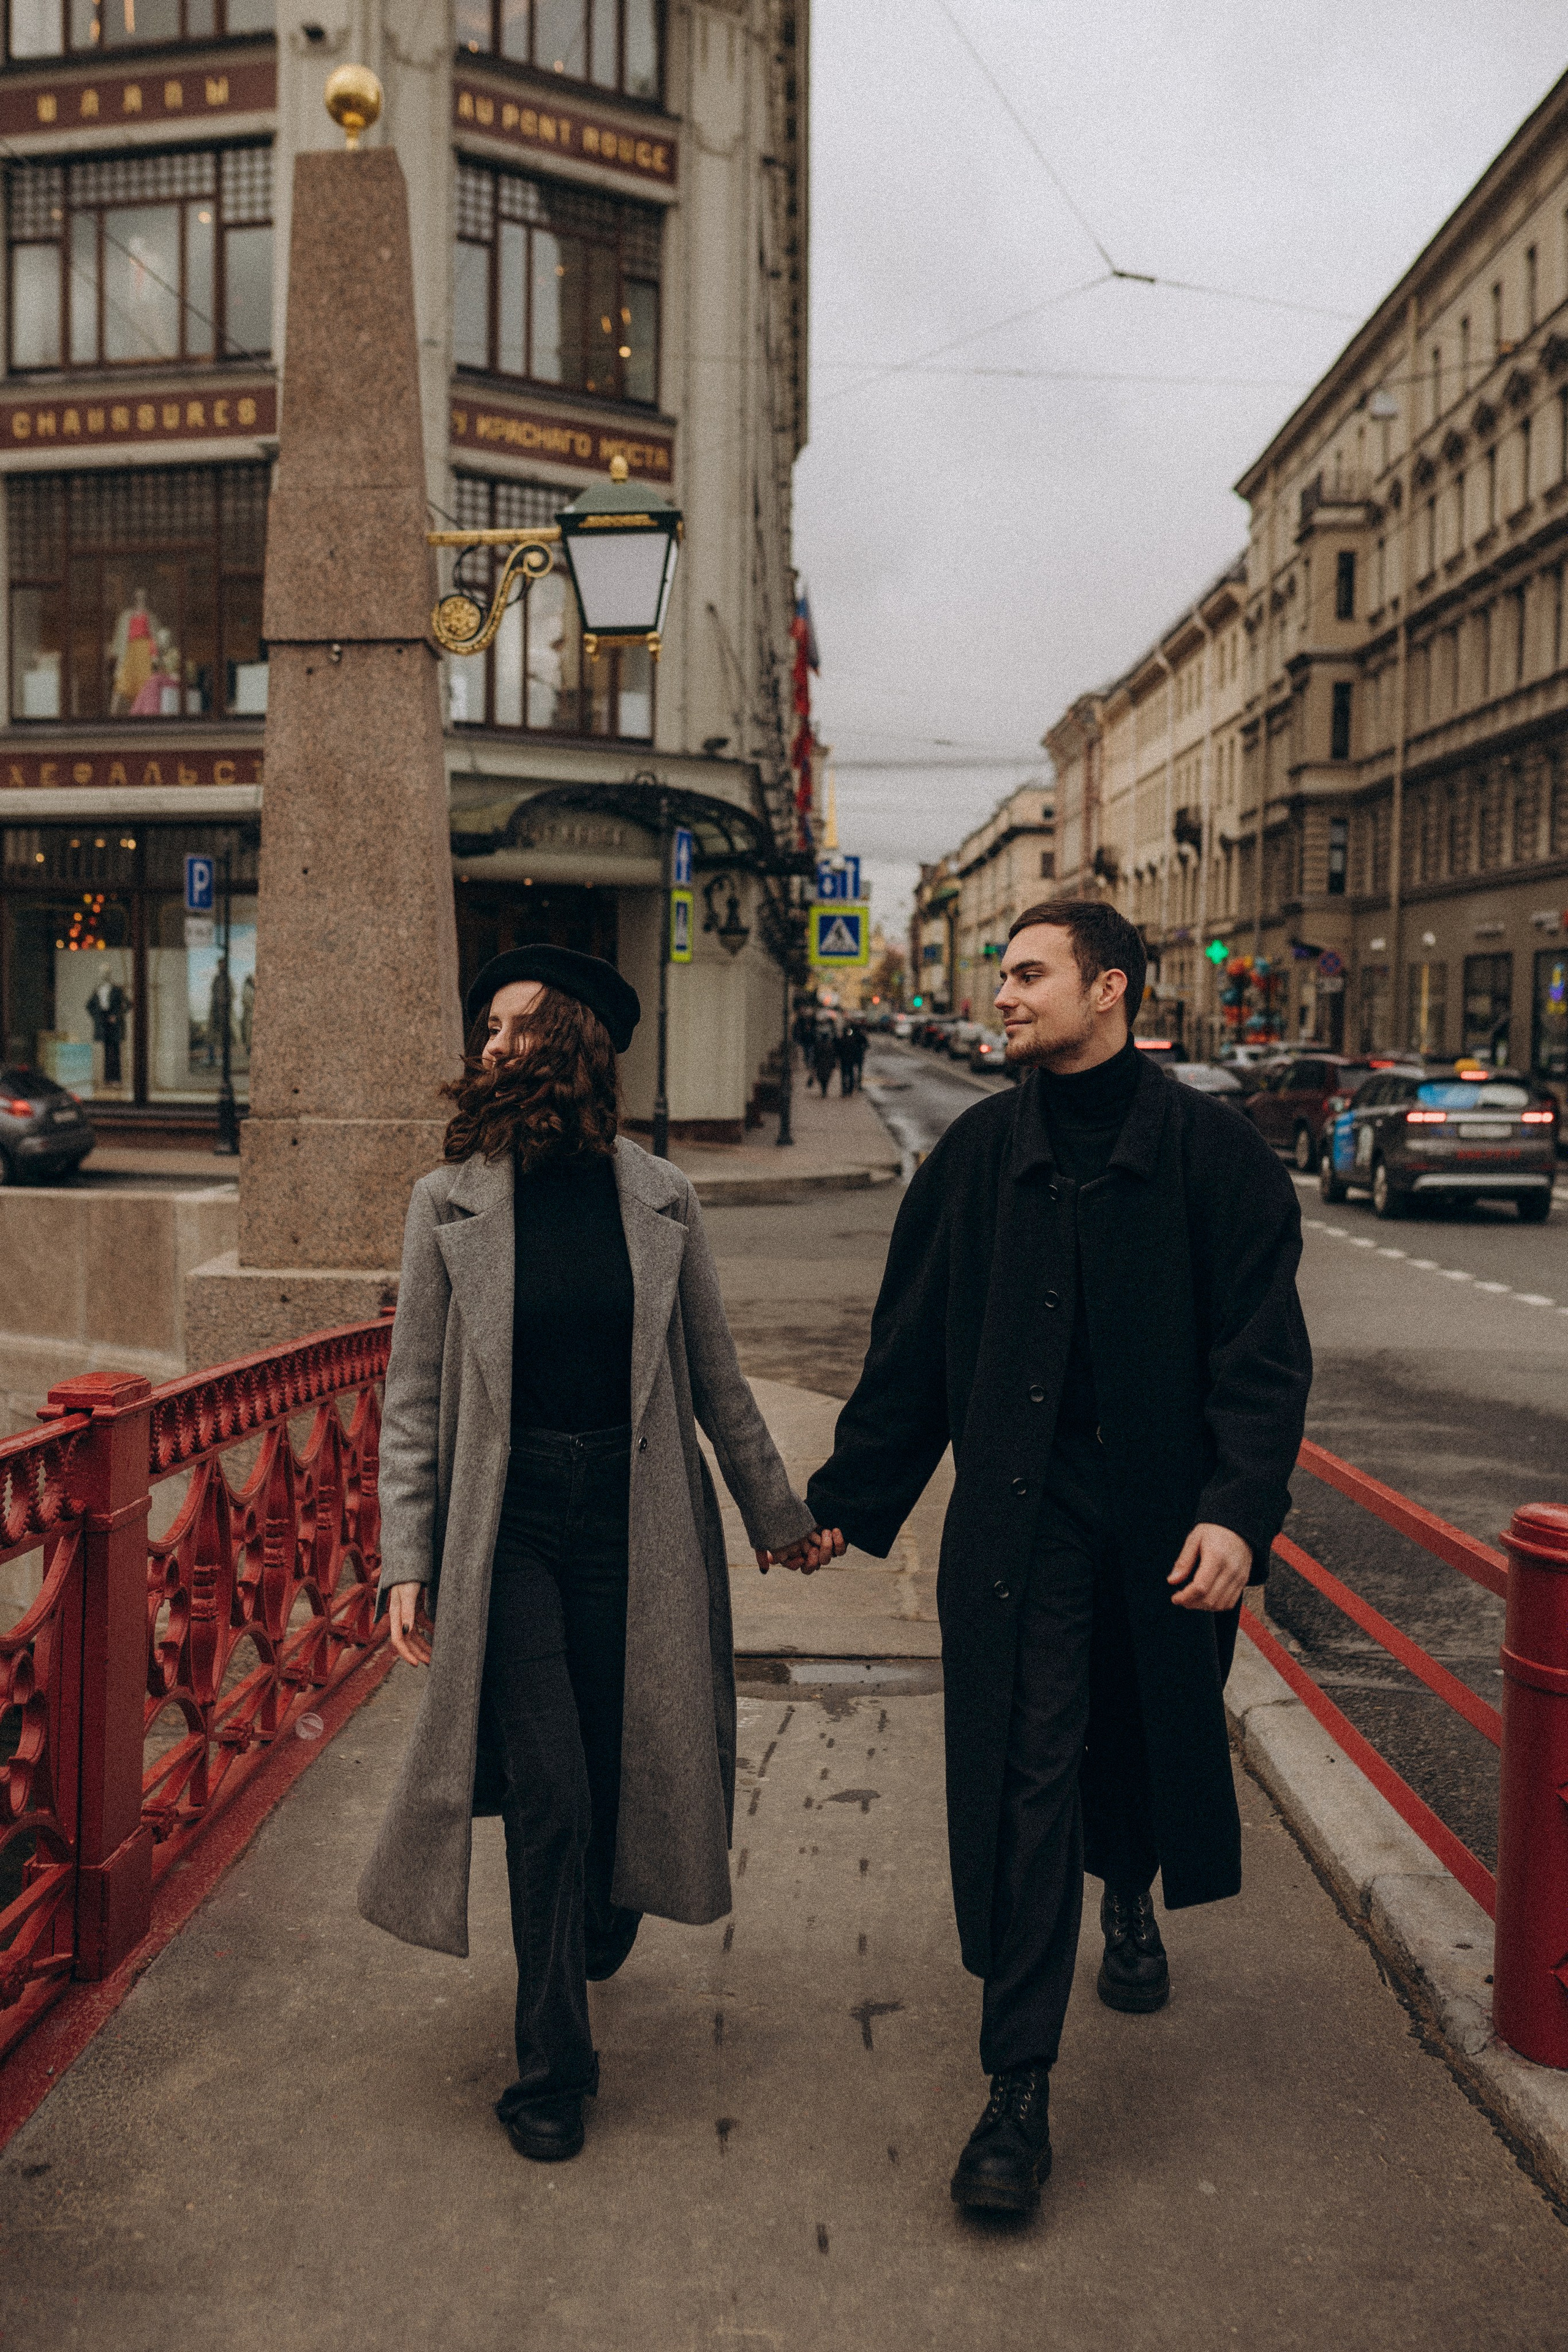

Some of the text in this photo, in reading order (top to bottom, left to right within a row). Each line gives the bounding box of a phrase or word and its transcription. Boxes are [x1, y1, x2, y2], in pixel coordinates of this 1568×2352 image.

[458, 91, 668, 172] AU PONT ROUGE
[192, 860, 211, 904] P
